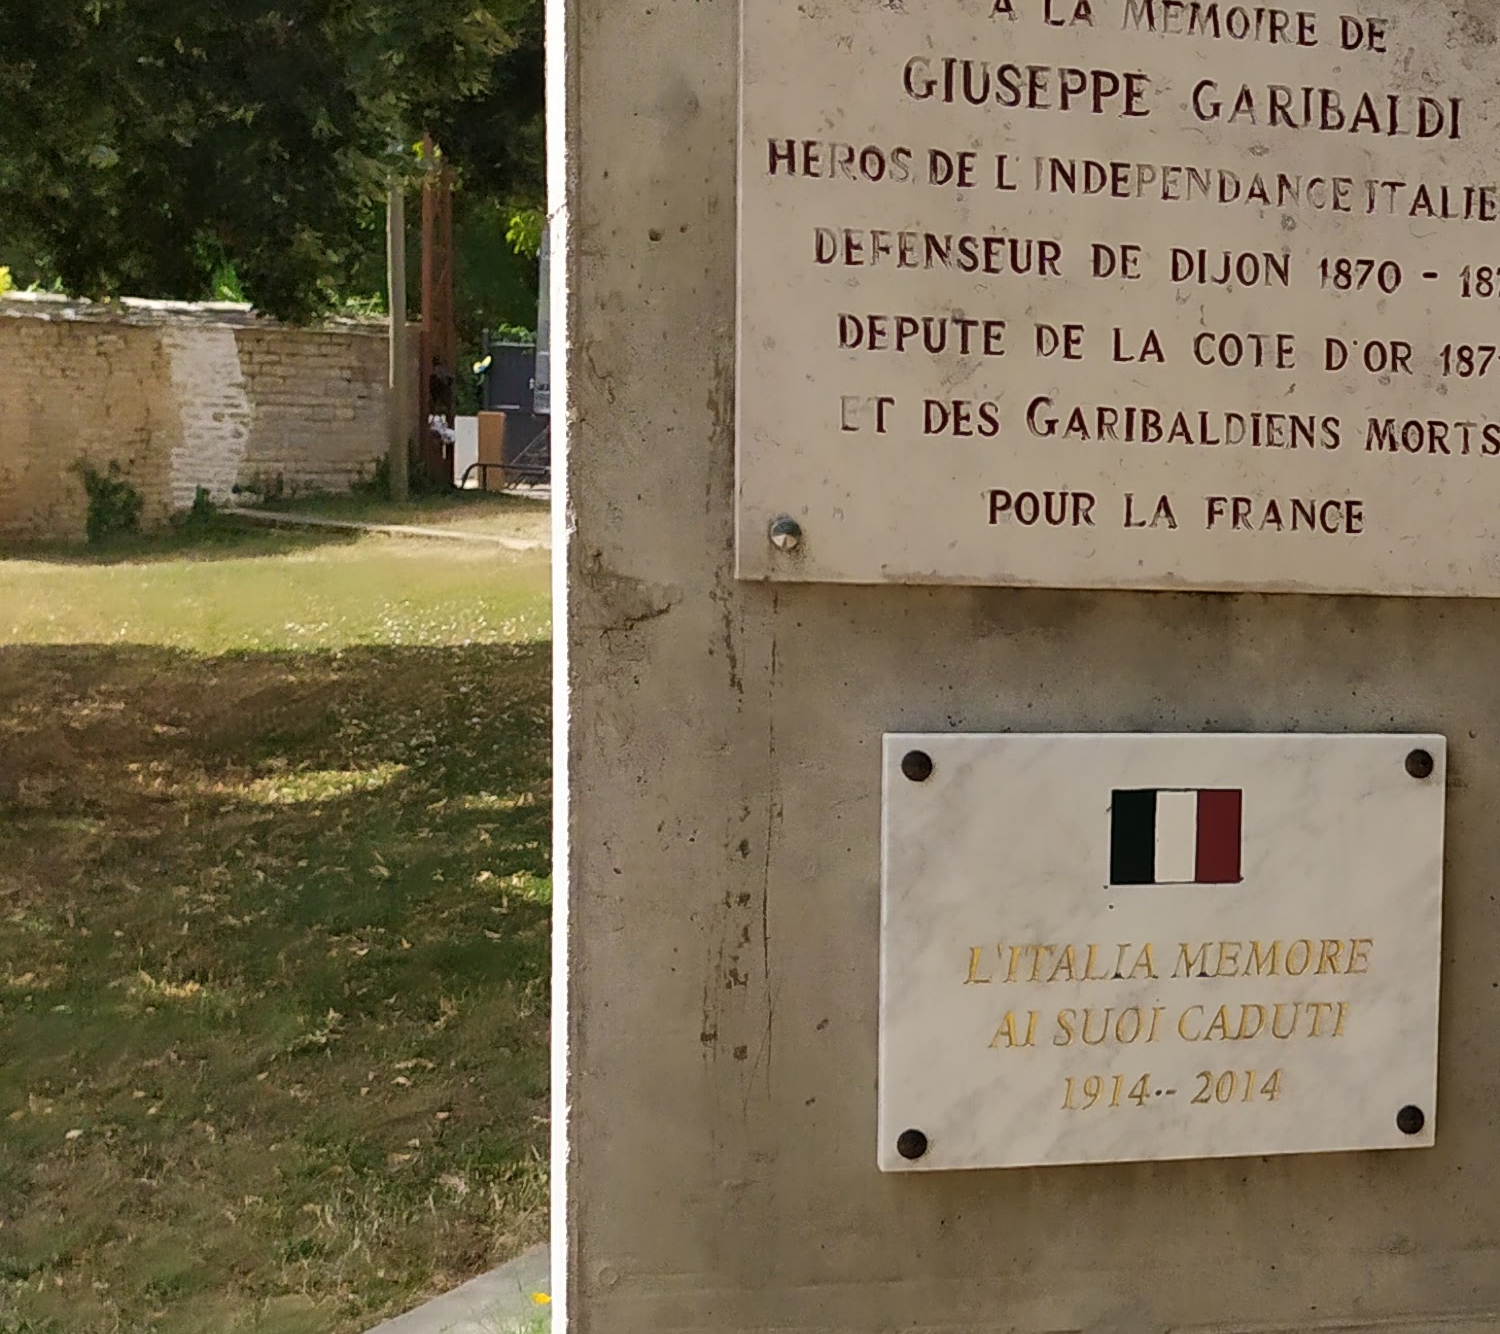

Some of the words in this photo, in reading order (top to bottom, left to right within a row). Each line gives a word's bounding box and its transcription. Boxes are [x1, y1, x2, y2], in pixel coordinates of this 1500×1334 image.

[1339, 15, 1389, 52] DE
[902, 56, 1151, 117] GIUSEPPE
[1192, 79, 1462, 139] GARIBALDI
[767, 138, 912, 183] HEROS
[927, 148, 977, 188] DE
[813, 227, 1062, 277] DEFENSEUR
[1091, 243, 1142, 279] DE
[1170, 247, 1291, 287] DIJON
[1319, 257, 1401, 293] 1870
[838, 314, 1006, 355] DEPUTE
[1035, 323, 1085, 359] DE
[1113, 327, 1165, 363] LA
[1194, 333, 1295, 368] COTE
[1325, 338, 1413, 376] D'OR
[840, 396, 895, 433] ET
[924, 399, 999, 436] DES
[1027, 396, 1340, 450] GARIBALDIENS
[988, 490, 1095, 526] POUR
[1124, 493, 1178, 528] LA
[1205, 496, 1365, 534] FRANCE
[963, 942, 1159, 985] L'ITALIA
[1171, 938, 1374, 979] MEMORE
[987, 1009, 1041, 1048] AI
[1052, 1003, 1166, 1047] SUOI
[1178, 1001, 1350, 1042] CADUTI
[1191, 1068, 1284, 1105] 2014
